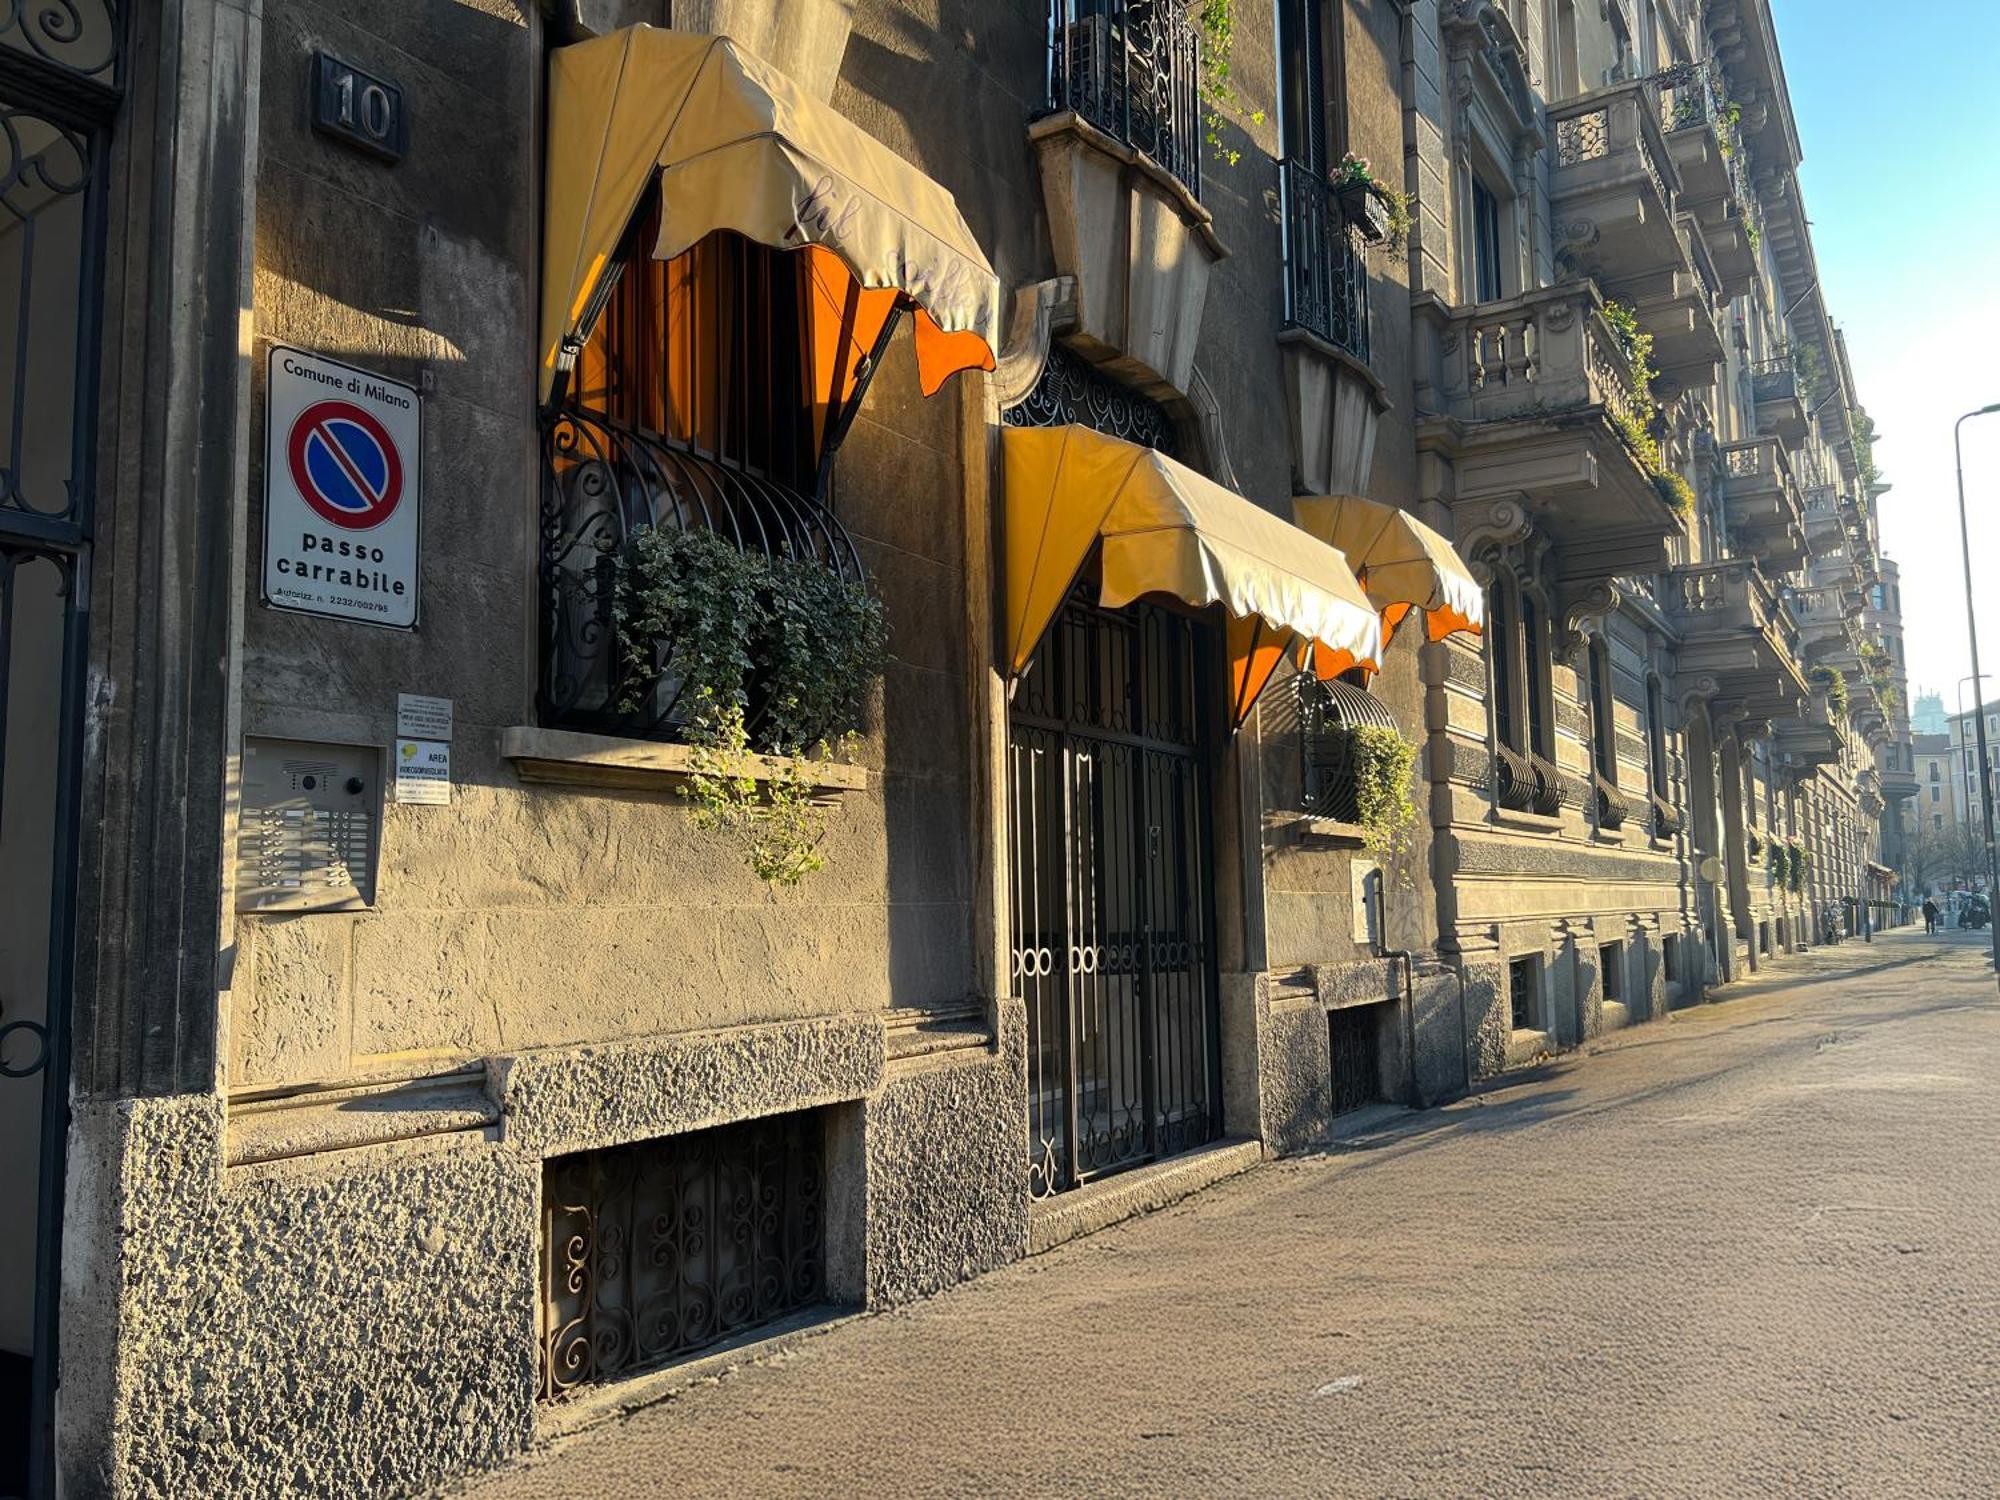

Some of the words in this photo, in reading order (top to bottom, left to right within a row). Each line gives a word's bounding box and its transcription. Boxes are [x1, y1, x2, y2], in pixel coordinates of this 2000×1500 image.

[334, 74, 390, 140] 10
[283, 358, 344, 389] Comune
[347, 377, 361, 395] di
[364, 383, 410, 410] Milano
[302, 532, 384, 564] passo
[276, 556, 405, 596] carrabile
[428, 753, 448, 764] AREA
